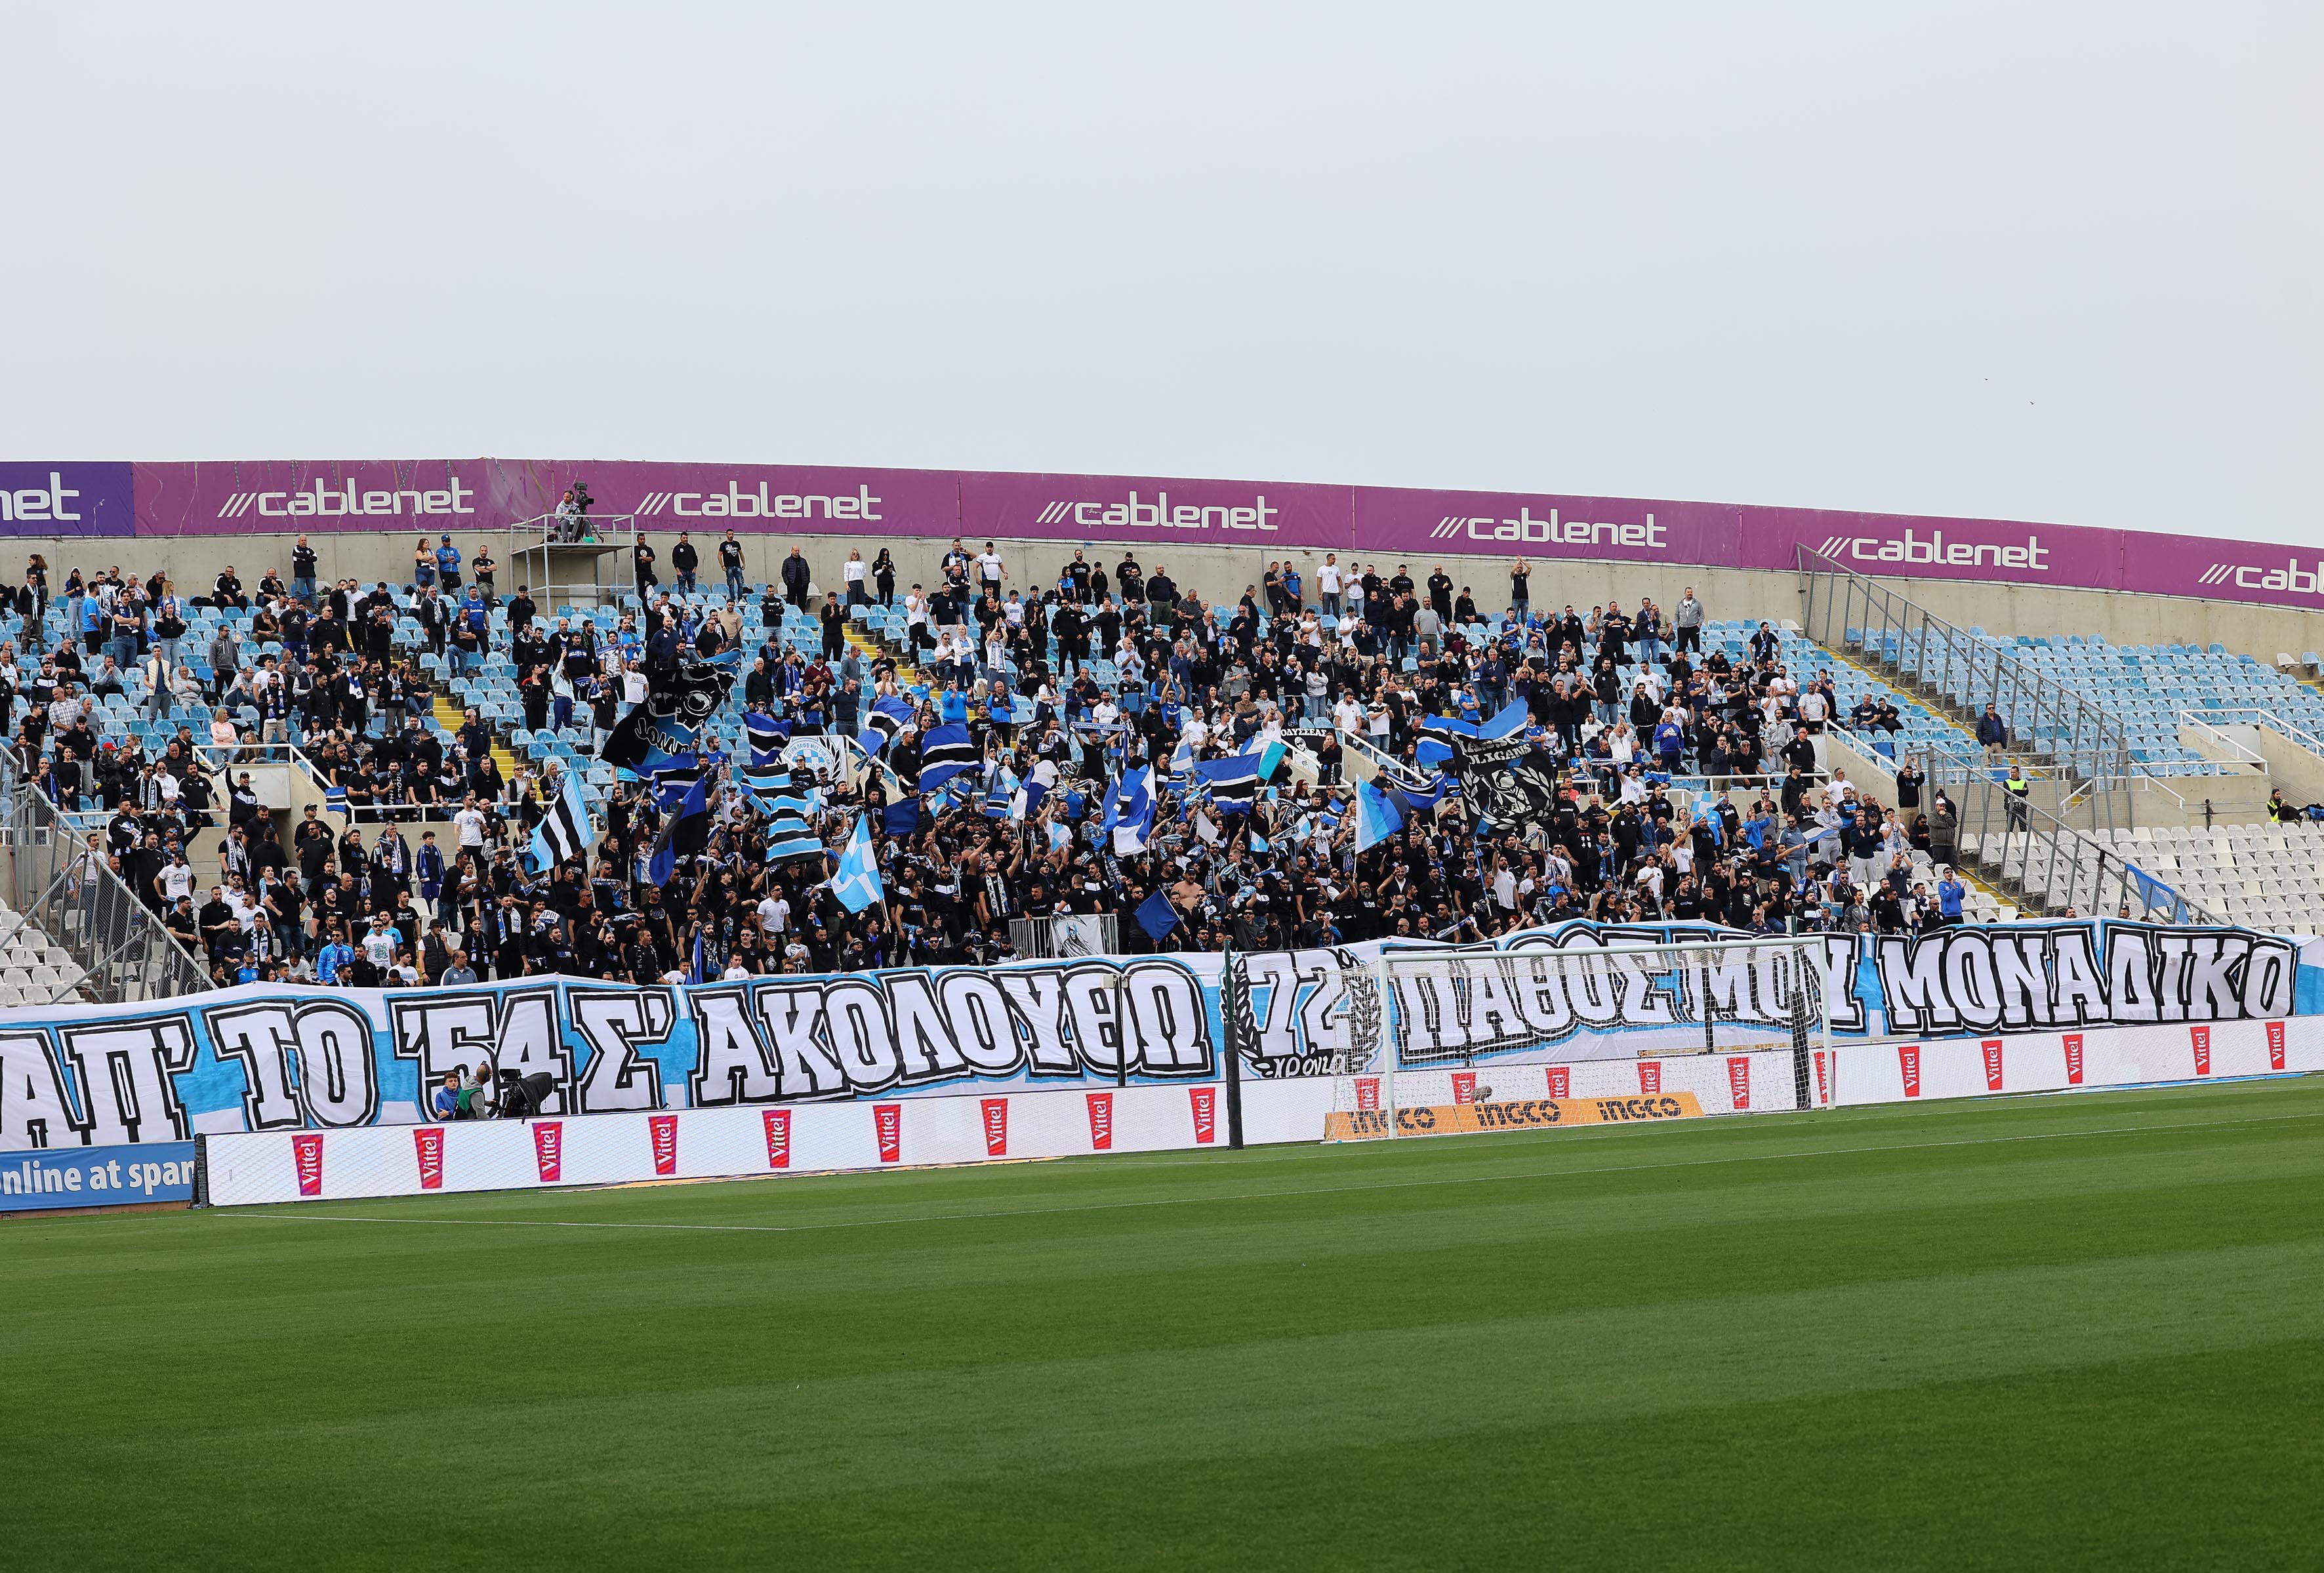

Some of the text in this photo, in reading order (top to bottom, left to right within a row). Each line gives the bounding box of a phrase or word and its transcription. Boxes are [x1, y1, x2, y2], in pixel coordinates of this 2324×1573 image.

[258, 477, 475, 516] cablenet
[674, 480, 882, 520] cablenet
[1074, 491, 1278, 530] cablenet
[1467, 507, 1667, 548] cablenet
[1852, 529, 2049, 570] cablenet
[1988, 1046, 2000, 1082] Vittel
[2068, 1040, 2080, 1076] Vittel
[2197, 1032, 2209, 1067] Vittel
[2271, 1027, 2283, 1062] Vittel
[1734, 1063, 1746, 1101] Vittel
[1904, 1052, 1917, 1089] Vittel
[881, 1112, 897, 1153] Vittel
[989, 1105, 1004, 1147] Vittel
[1093, 1100, 1109, 1141] Vittel
[1196, 1094, 1211, 1134] Vittel
[422, 1136, 439, 1179] Vittel
[541, 1130, 556, 1172] Vittel
[657, 1123, 672, 1166] Vittel
[770, 1117, 786, 1158] Vittel
[0, 1160, 81, 1195] nline
[89, 1160, 122, 1190] at
[301, 1142, 317, 1185] Vittel
